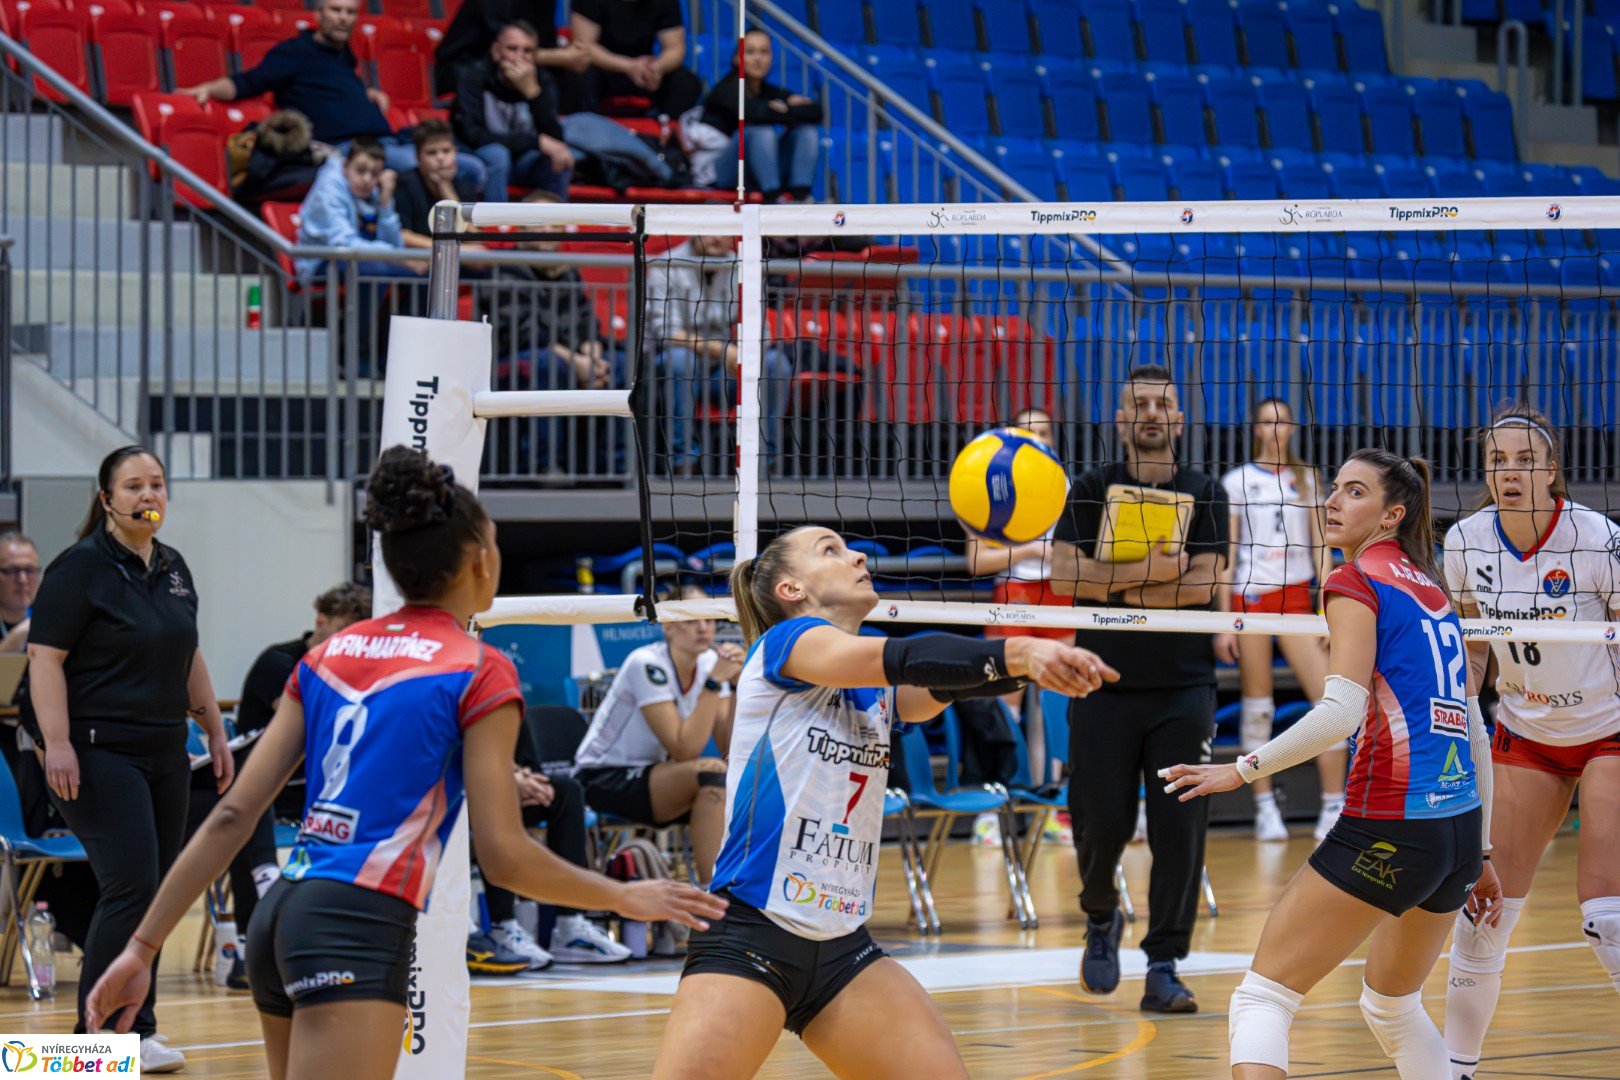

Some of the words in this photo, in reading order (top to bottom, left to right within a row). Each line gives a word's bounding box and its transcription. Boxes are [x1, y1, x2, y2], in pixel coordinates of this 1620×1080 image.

[1031, 209, 1097, 225] TippmixPRO
[1389, 206, 1458, 221] TippmixPRO
[1092, 613, 1147, 626] TippmixPRO
[1478, 600, 1567, 621] TippmixPRO
[1461, 625, 1513, 637] ippmixPRO
[1421, 619, 1467, 702] 12
[1434, 708, 1467, 729] STRABAG
[842, 772, 868, 825] 7
[790, 816, 875, 865] FATUM
[1355, 850, 1404, 885] EAK
